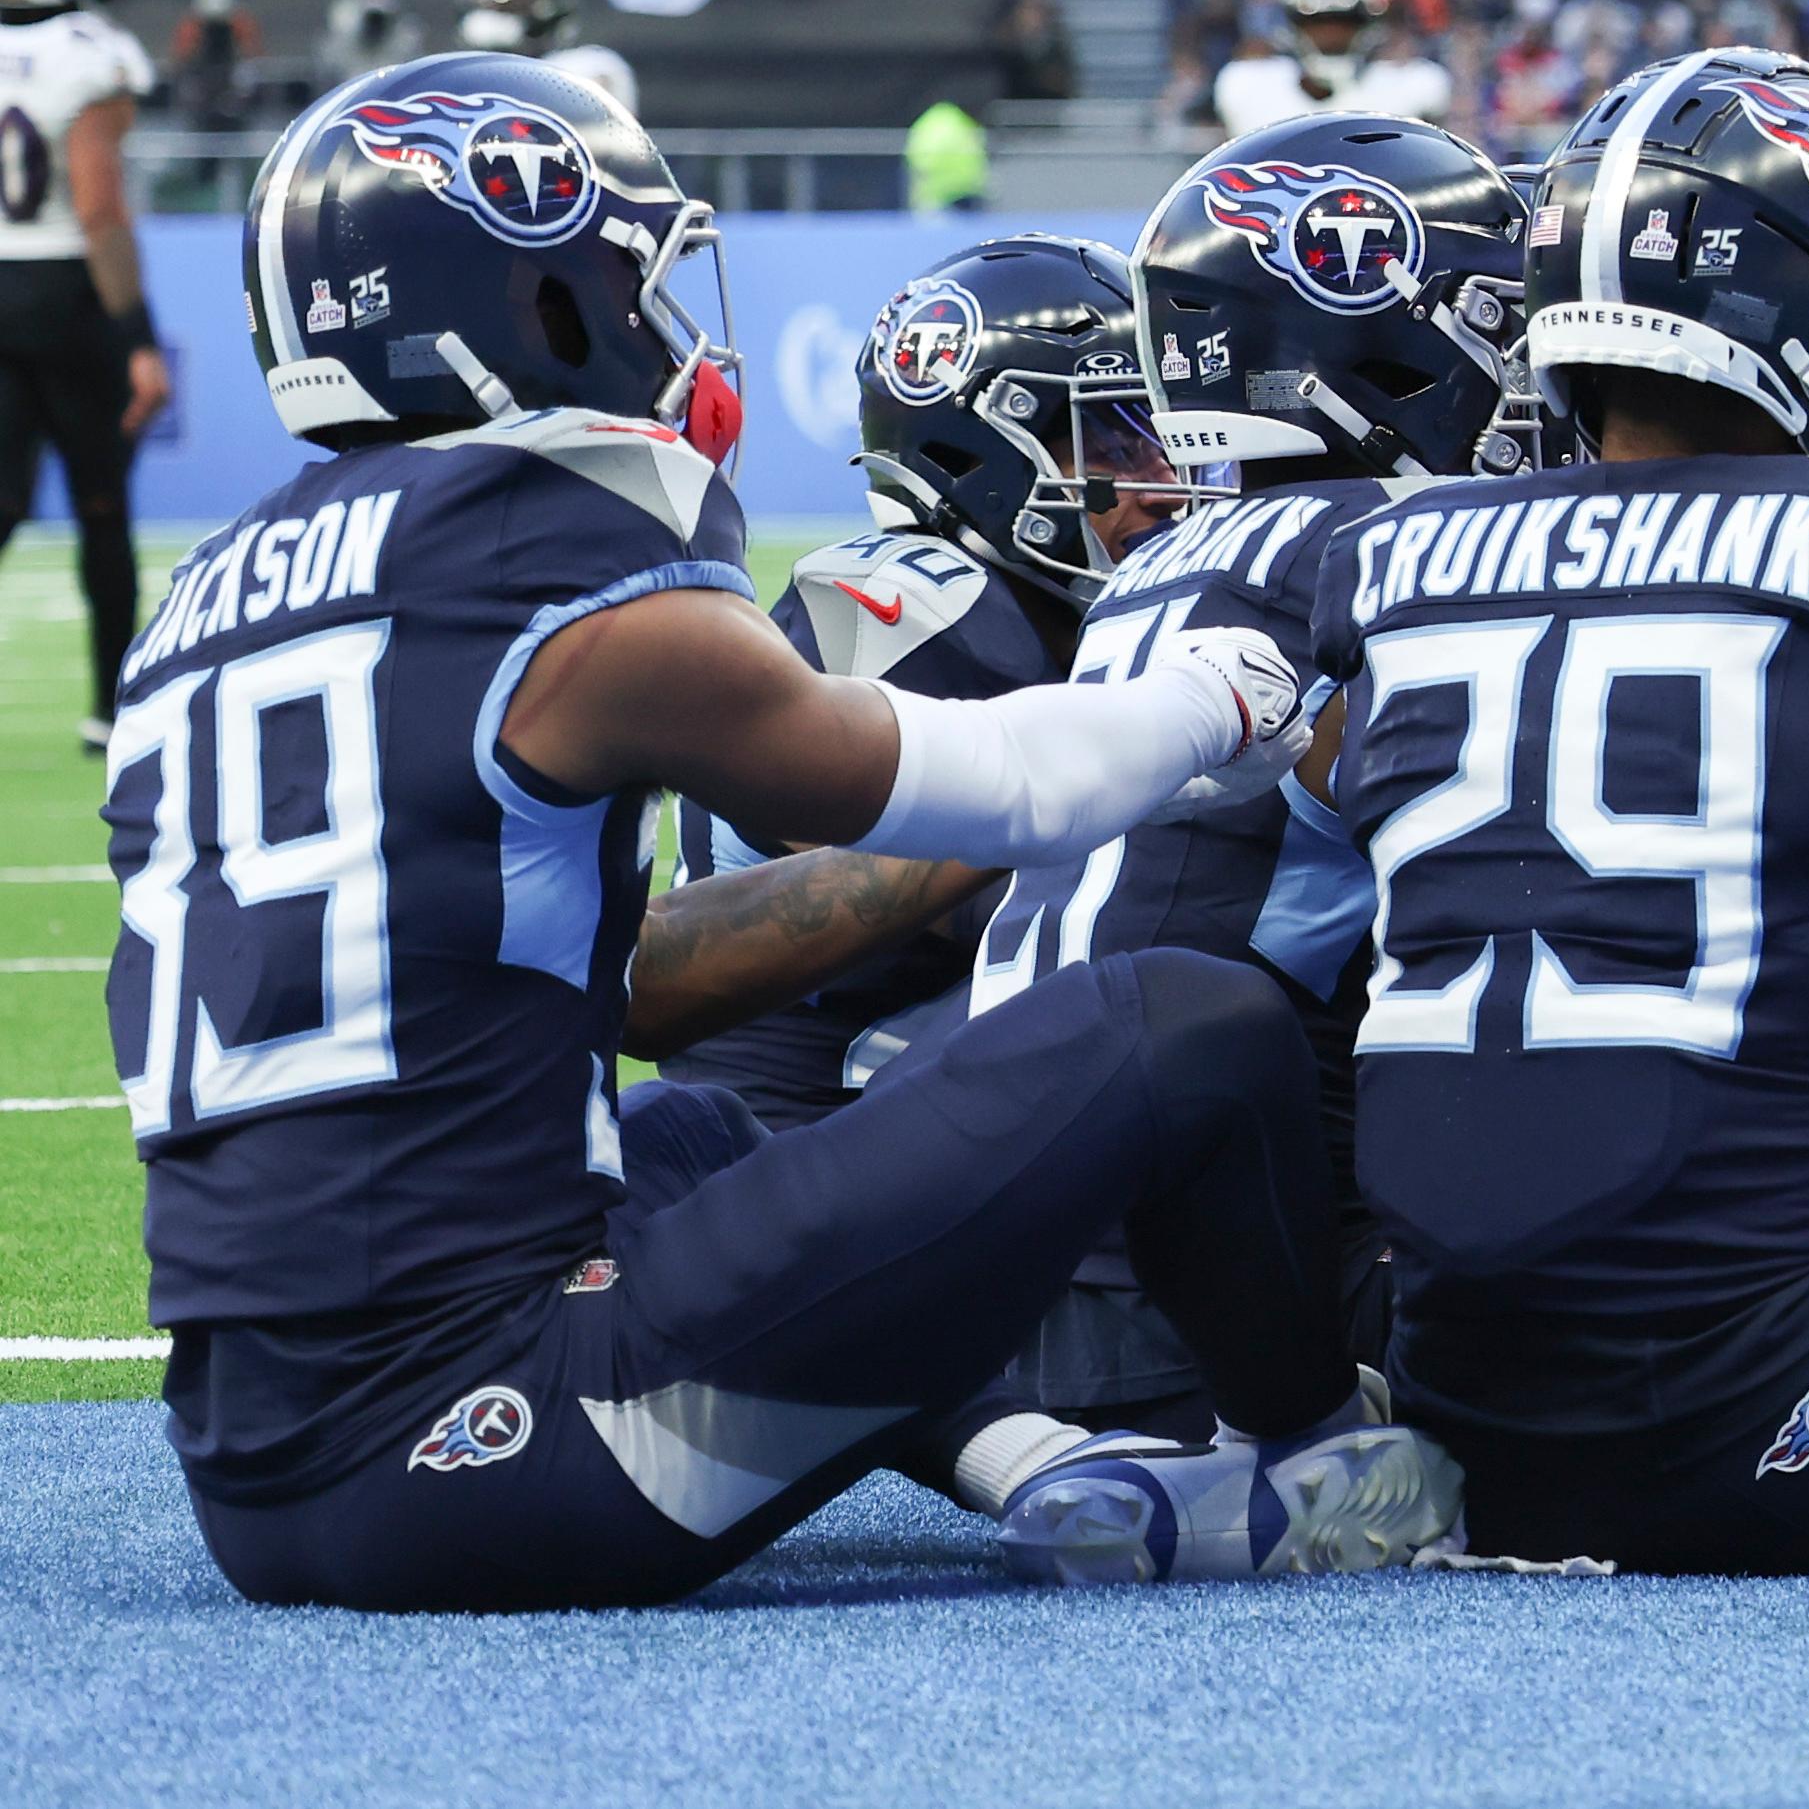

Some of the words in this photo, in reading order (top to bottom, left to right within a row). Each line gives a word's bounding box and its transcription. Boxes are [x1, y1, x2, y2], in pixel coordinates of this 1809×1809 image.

[1633, 237, 1676, 253] CATCH
[1695, 229, 1743, 266] 25
[349, 266, 391, 319] 25
[309, 308, 343, 325] CATCH
[1541, 309, 1684, 337] TENNESSEE
[1163, 360, 1189, 373] CATCH
[1196, 330, 1231, 377] 25
[271, 374, 345, 397] TENNESSEE
[123, 489, 402, 685] JACKSON
[1353, 613, 1790, 1060] 29
